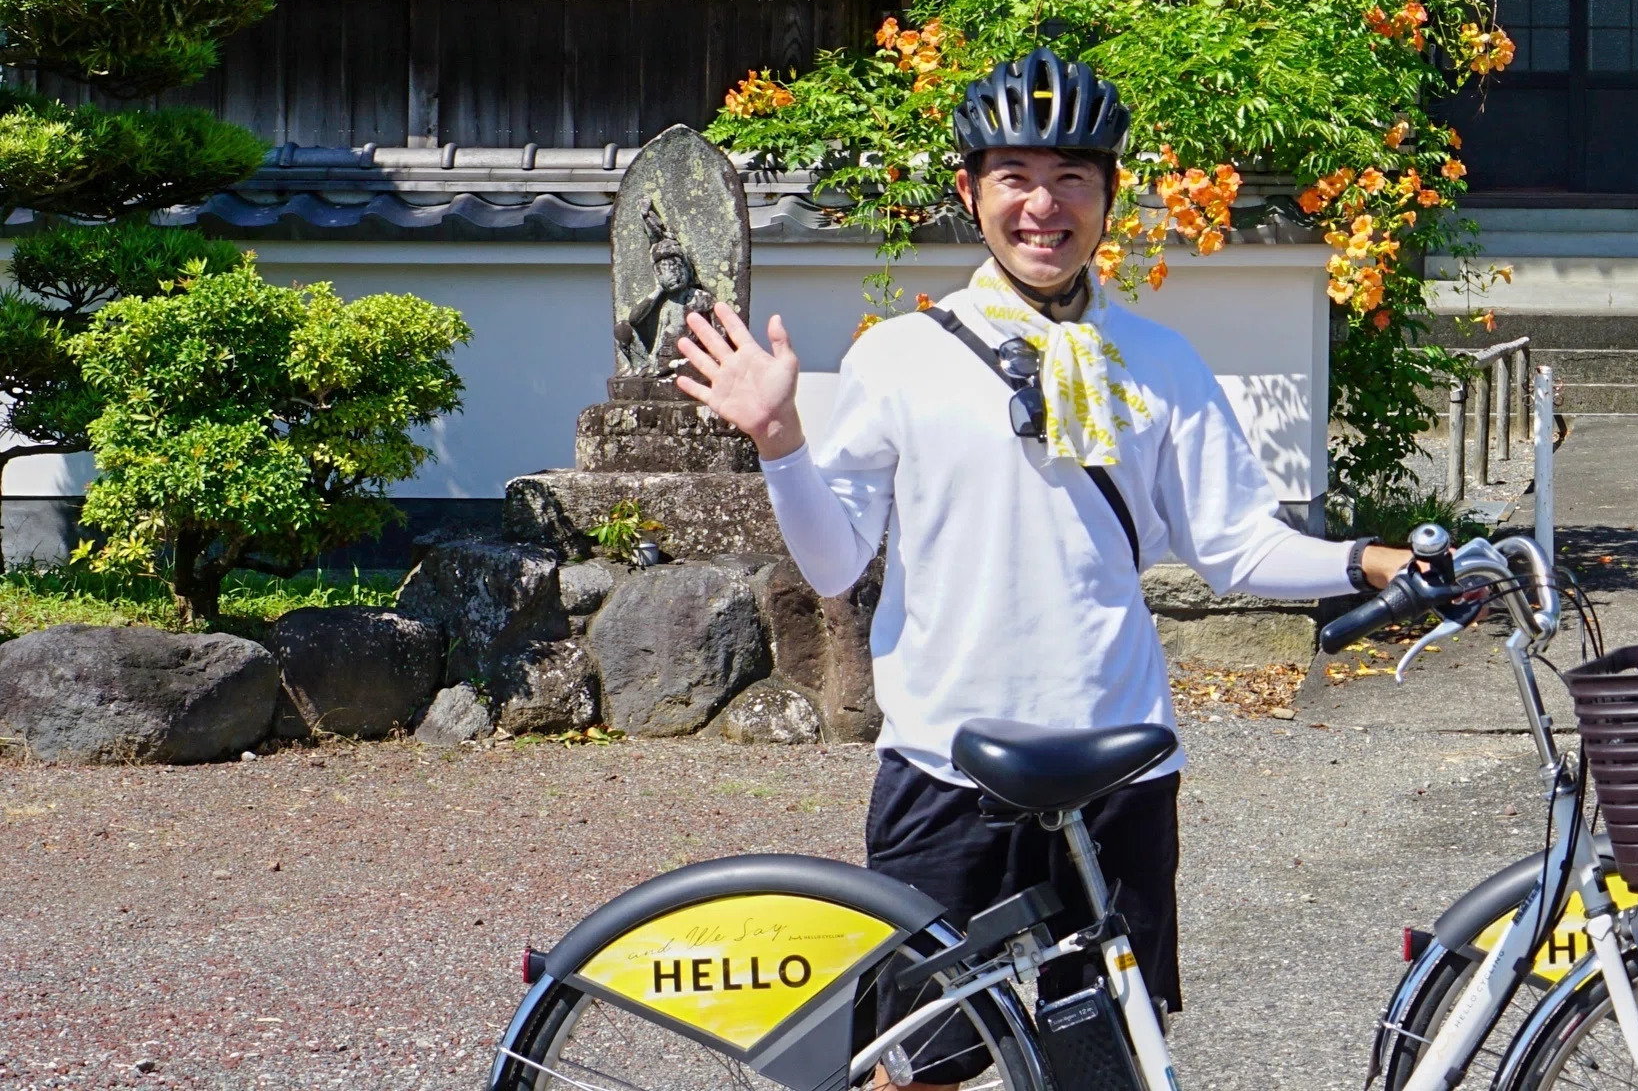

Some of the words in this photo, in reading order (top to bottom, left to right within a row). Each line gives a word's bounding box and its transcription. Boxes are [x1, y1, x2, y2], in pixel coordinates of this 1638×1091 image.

[685, 925, 725, 949] We
[733, 917, 788, 942] Say
[653, 954, 812, 993] HELLO
[1455, 994, 1477, 1028] HELLO
[1476, 950, 1505, 993] CYCLING
